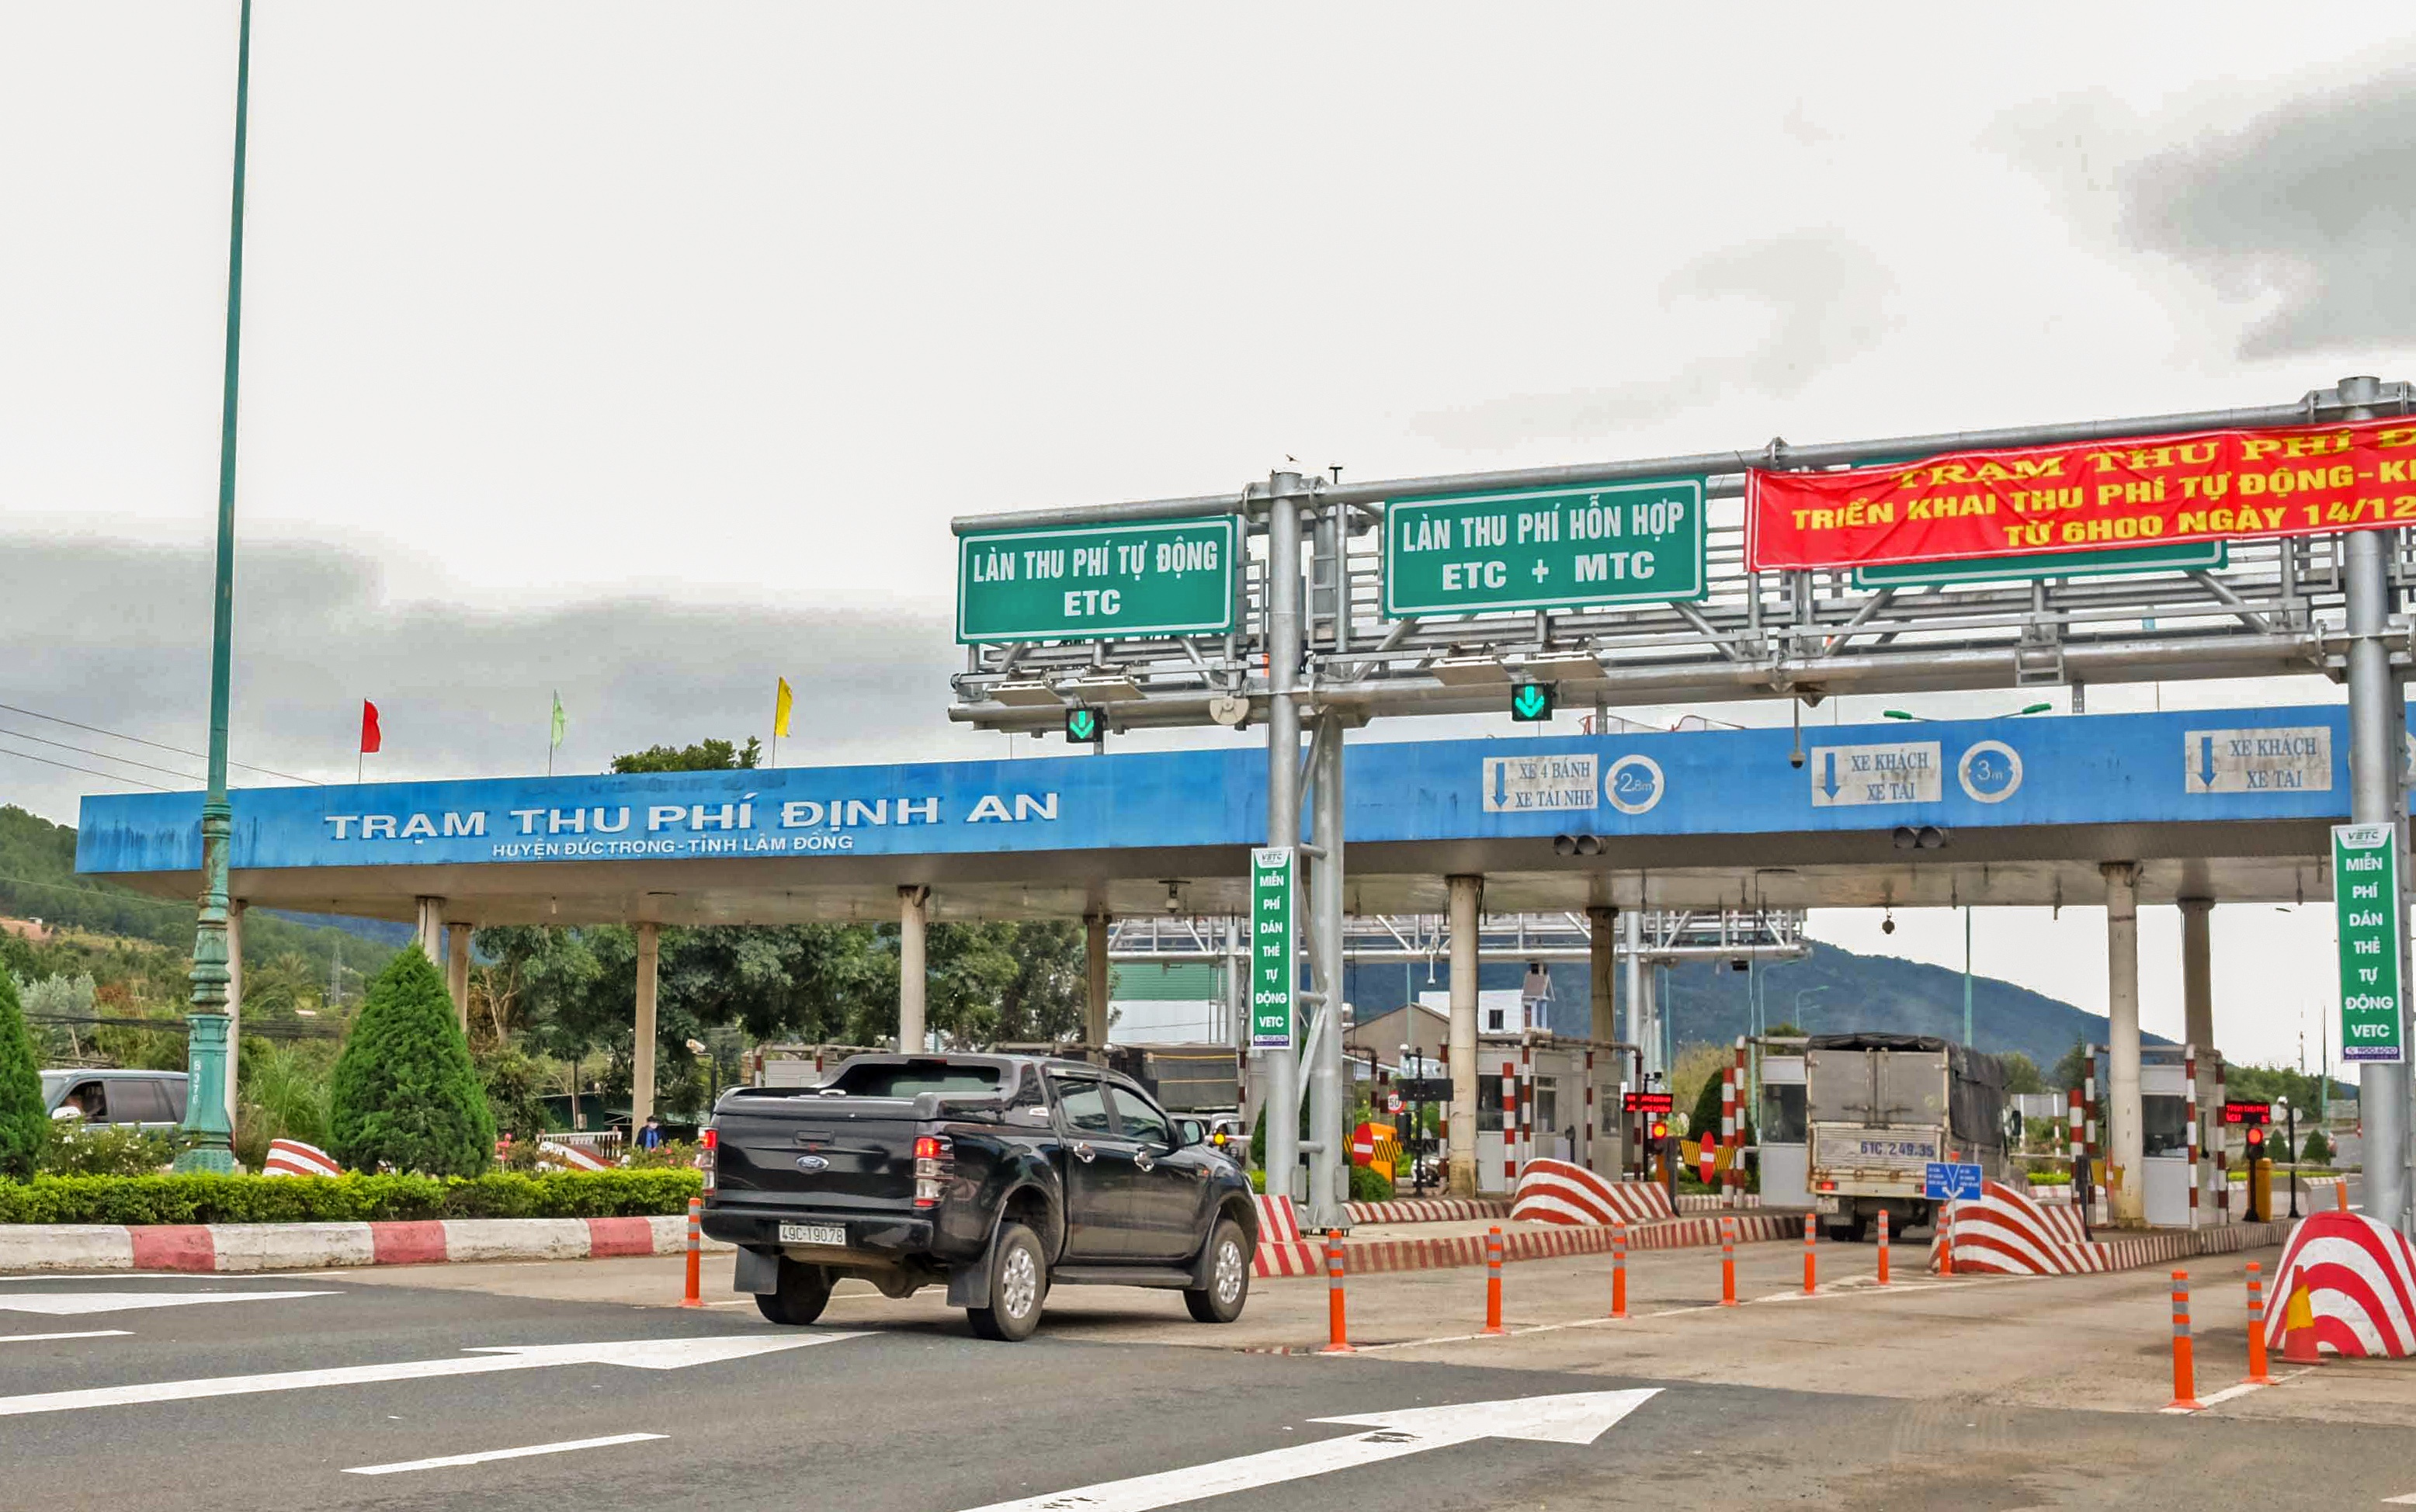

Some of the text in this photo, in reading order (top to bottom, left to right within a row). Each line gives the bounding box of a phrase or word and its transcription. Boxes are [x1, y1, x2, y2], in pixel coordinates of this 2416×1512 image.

[1889, 456, 2066, 488] TRẠM
[2084, 442, 2220, 473] THU
[2241, 428, 2354, 461] PHÍ
[1791, 497, 1894, 530] TRIỂN
[1907, 494, 1996, 521] KHAI
[2009, 487, 2083, 512] THU
[2098, 477, 2166, 505] PHÍ
[2178, 470, 2231, 501] TỰ
[2238, 465, 2354, 498] ĐỘNG
[1403, 494, 1684, 552] LÀN THU PHÍ HỖN HỢP
[2003, 519, 2055, 546] TỪ
[2062, 515, 2164, 543] 6H00
[2178, 503, 2286, 534] NGÀY
[974, 536, 1217, 582] LÀN THU PHÍ TỰ ĐỘNG
[1442, 560, 1507, 591] ETC
[1574, 551, 1655, 582] MTC
[1064, 589, 1121, 616] ETC
[2229, 732, 2317, 757] XE KHÁCH
[1519, 758, 1590, 779] XE 4 BÁNH
[1851, 748, 1930, 772] XE KHÁCH
[2246, 770, 2268, 788] XE
[1515, 792, 1533, 807] XE
[1867, 784, 1885, 800] XE
[325, 792, 1058, 844] TRẠM THU PHÍ ĐỊNH AN
[492, 838, 558, 859] HUYỆN
[564, 837, 604, 855] ĐỨC
[743, 833, 786, 851] LÂM
[793, 828, 853, 851] ĐỒNG
[2348, 831, 2379, 840] VETC
[2345, 852, 2383, 872] MIỄN
[1259, 871, 1284, 886] MIỄN
[2352, 882, 2378, 899] PHÍ
[1263, 896, 1281, 910] PHÍ
[1260, 919, 1283, 934] DÁN
[2349, 910, 2383, 927] DÁN
[2353, 936, 2380, 955] THẺ
[1265, 969, 1279, 983] TỰ
[2359, 967, 2378, 986] TỰ
[1255, 990, 1287, 1007] ĐỘNG
[2345, 994, 2393, 1014] ĐỘNG
[1258, 1016, 1284, 1028] VETC
[2352, 1025, 2390, 1038] VETC
[1389, 1097, 1400, 1108] 50
